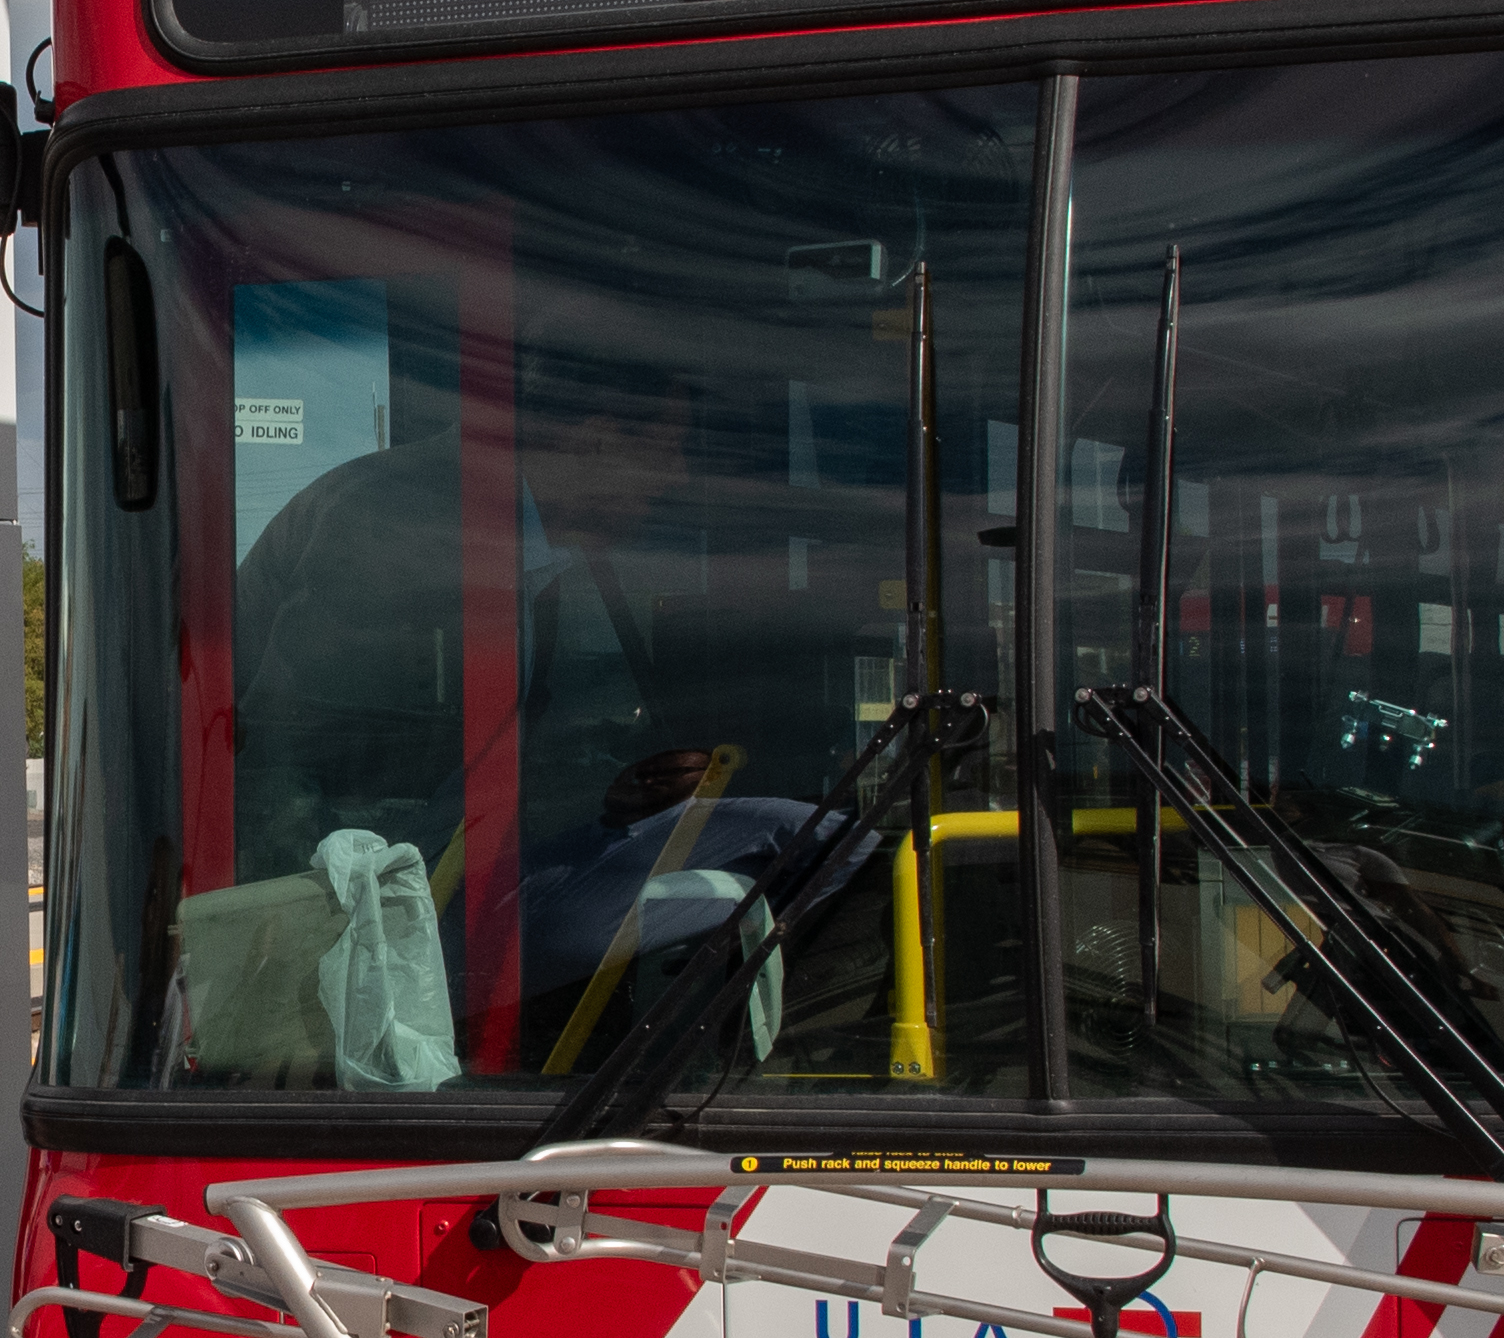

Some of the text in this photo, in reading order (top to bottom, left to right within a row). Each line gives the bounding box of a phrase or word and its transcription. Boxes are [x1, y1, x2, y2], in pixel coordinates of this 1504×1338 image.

[249, 404, 270, 414] OFF
[273, 405, 301, 415] ONLY
[251, 425, 298, 439] IDLING
[783, 1158, 817, 1169] Push
[821, 1158, 850, 1169] rack
[854, 1158, 880, 1169] and
[884, 1159, 940, 1171] squeeze
[944, 1159, 991, 1170] handle
[994, 1160, 1009, 1170] to
[1013, 1160, 1052, 1171] lower
